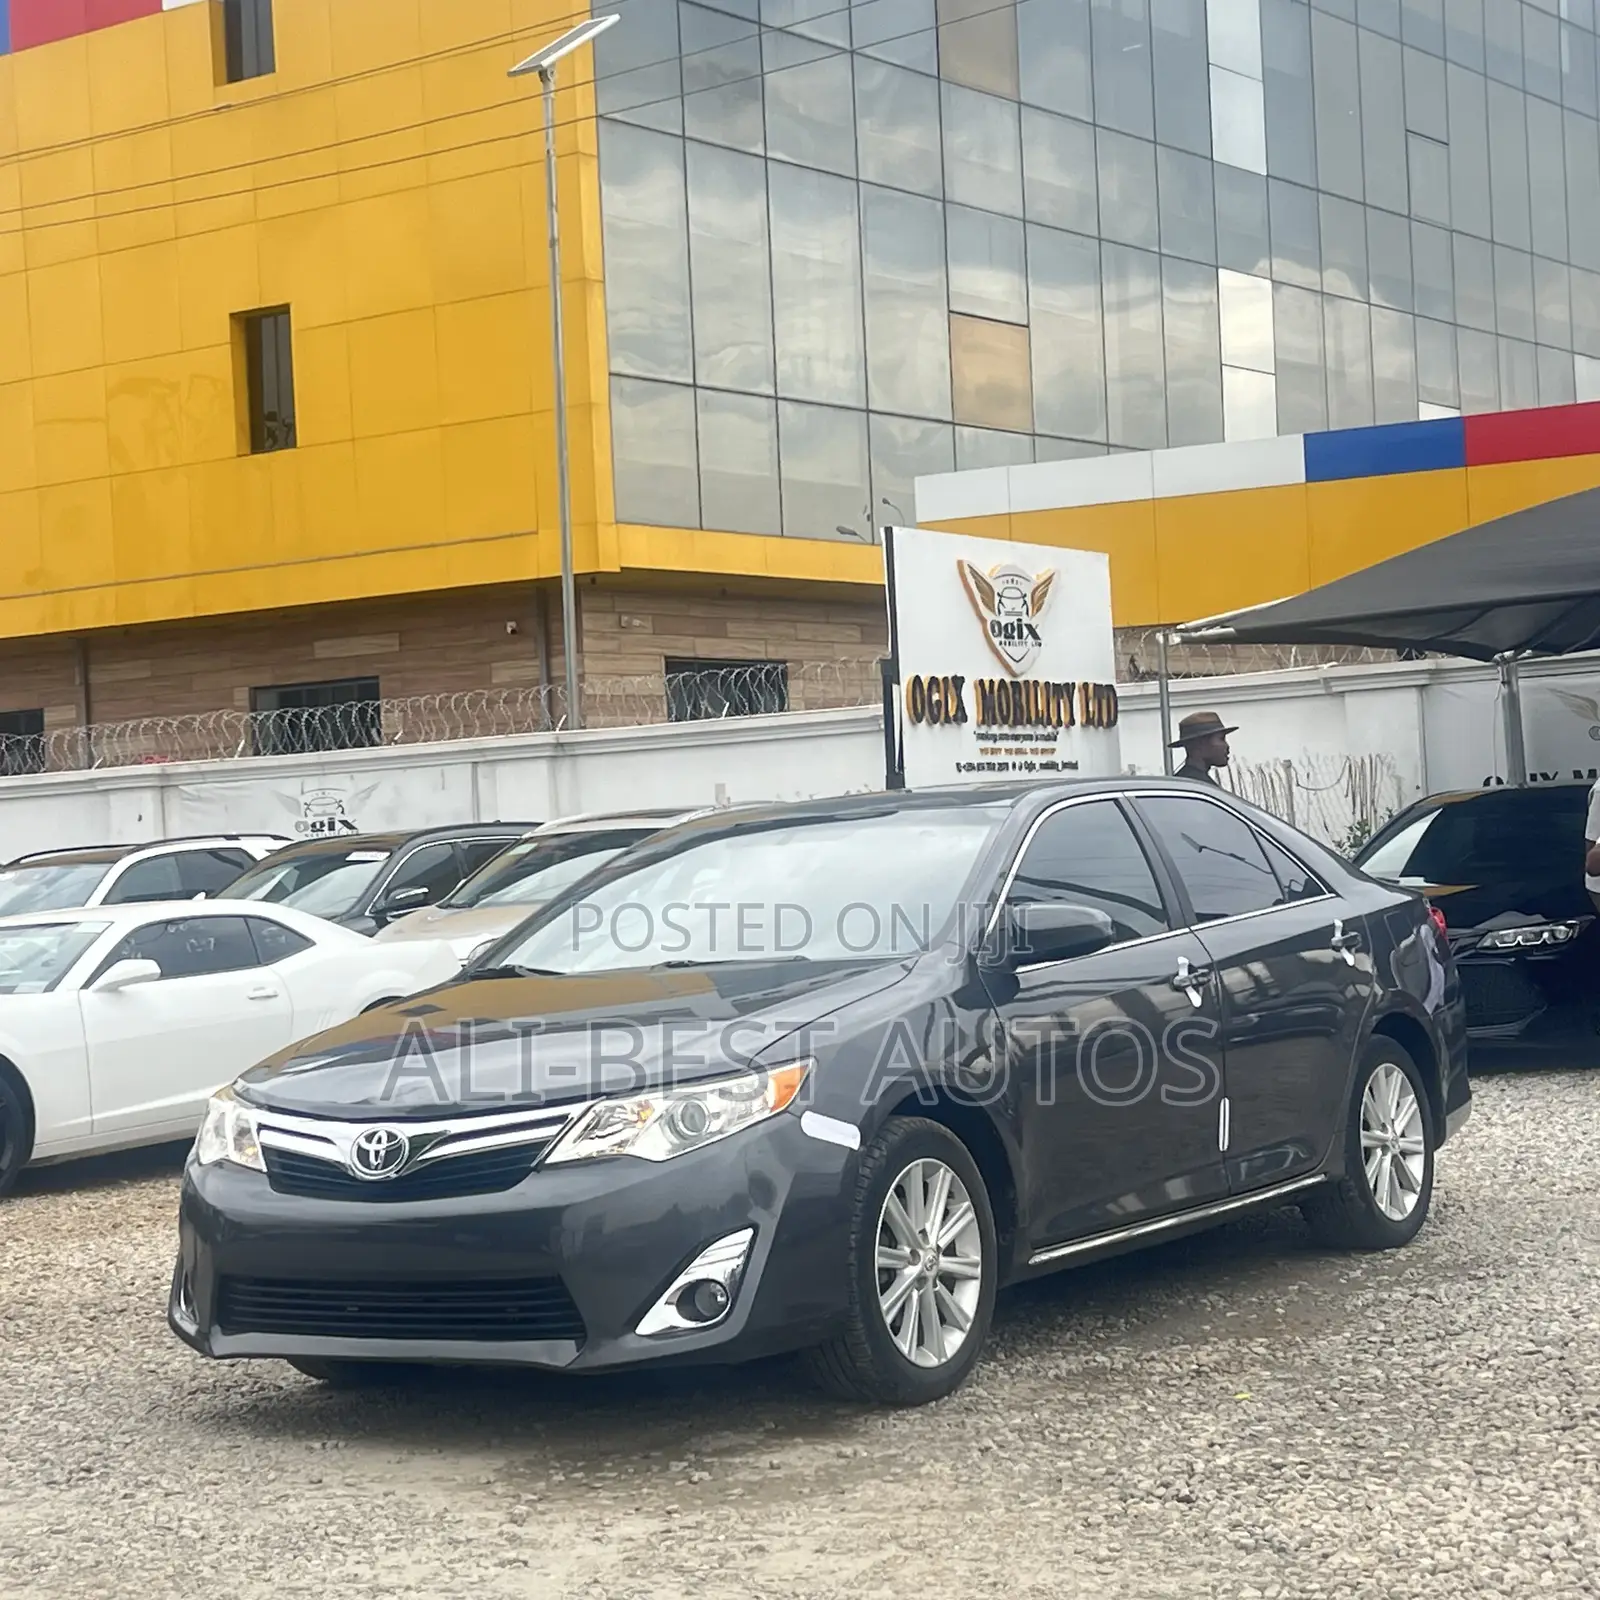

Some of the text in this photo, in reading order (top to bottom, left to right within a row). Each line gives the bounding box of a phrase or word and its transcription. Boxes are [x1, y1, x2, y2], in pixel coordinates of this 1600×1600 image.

[906, 674, 1119, 728] OGIX MOBILITY LTD
